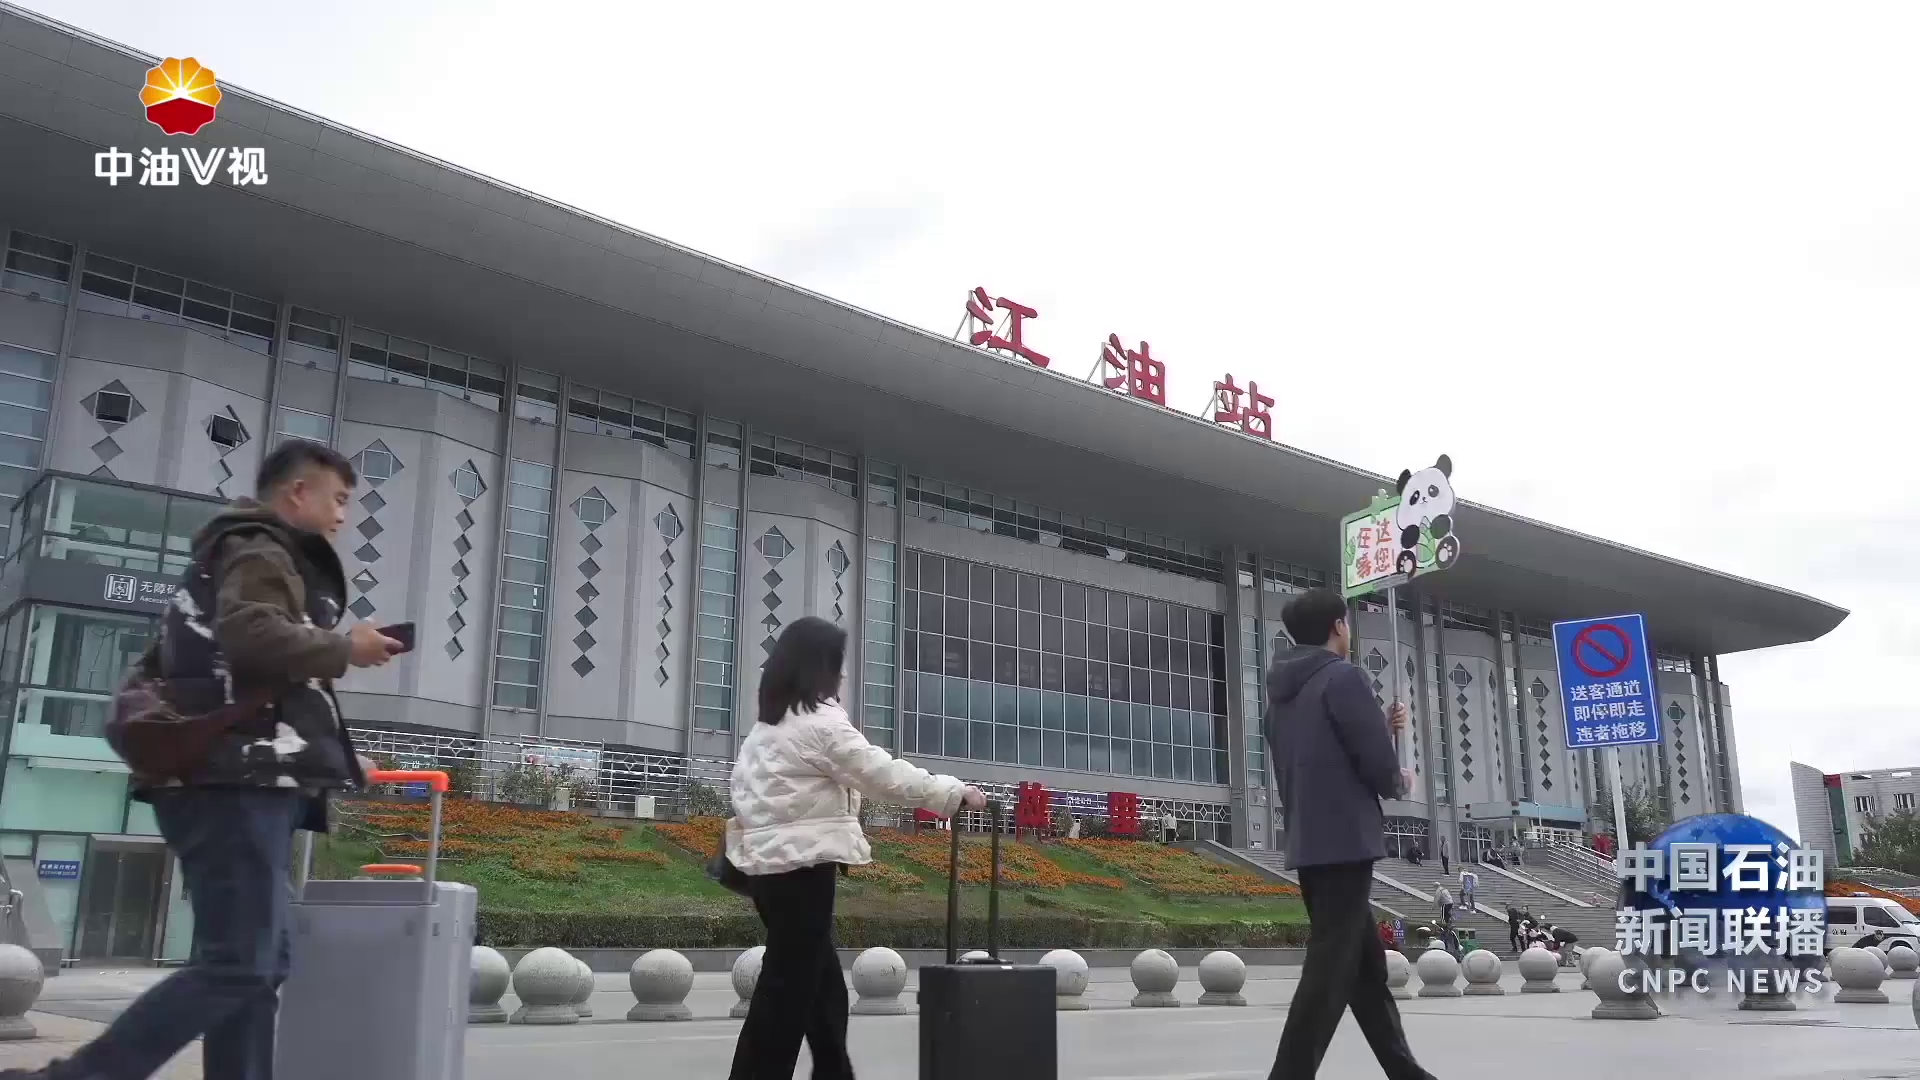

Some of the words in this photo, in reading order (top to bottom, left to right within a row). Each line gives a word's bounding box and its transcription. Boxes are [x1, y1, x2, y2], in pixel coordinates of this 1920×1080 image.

[966, 286, 1275, 441] 江油站
[1570, 679, 1642, 702] 送客通道
[1573, 699, 1646, 722] 即停即走
[1576, 720, 1647, 743] 违者拖移
